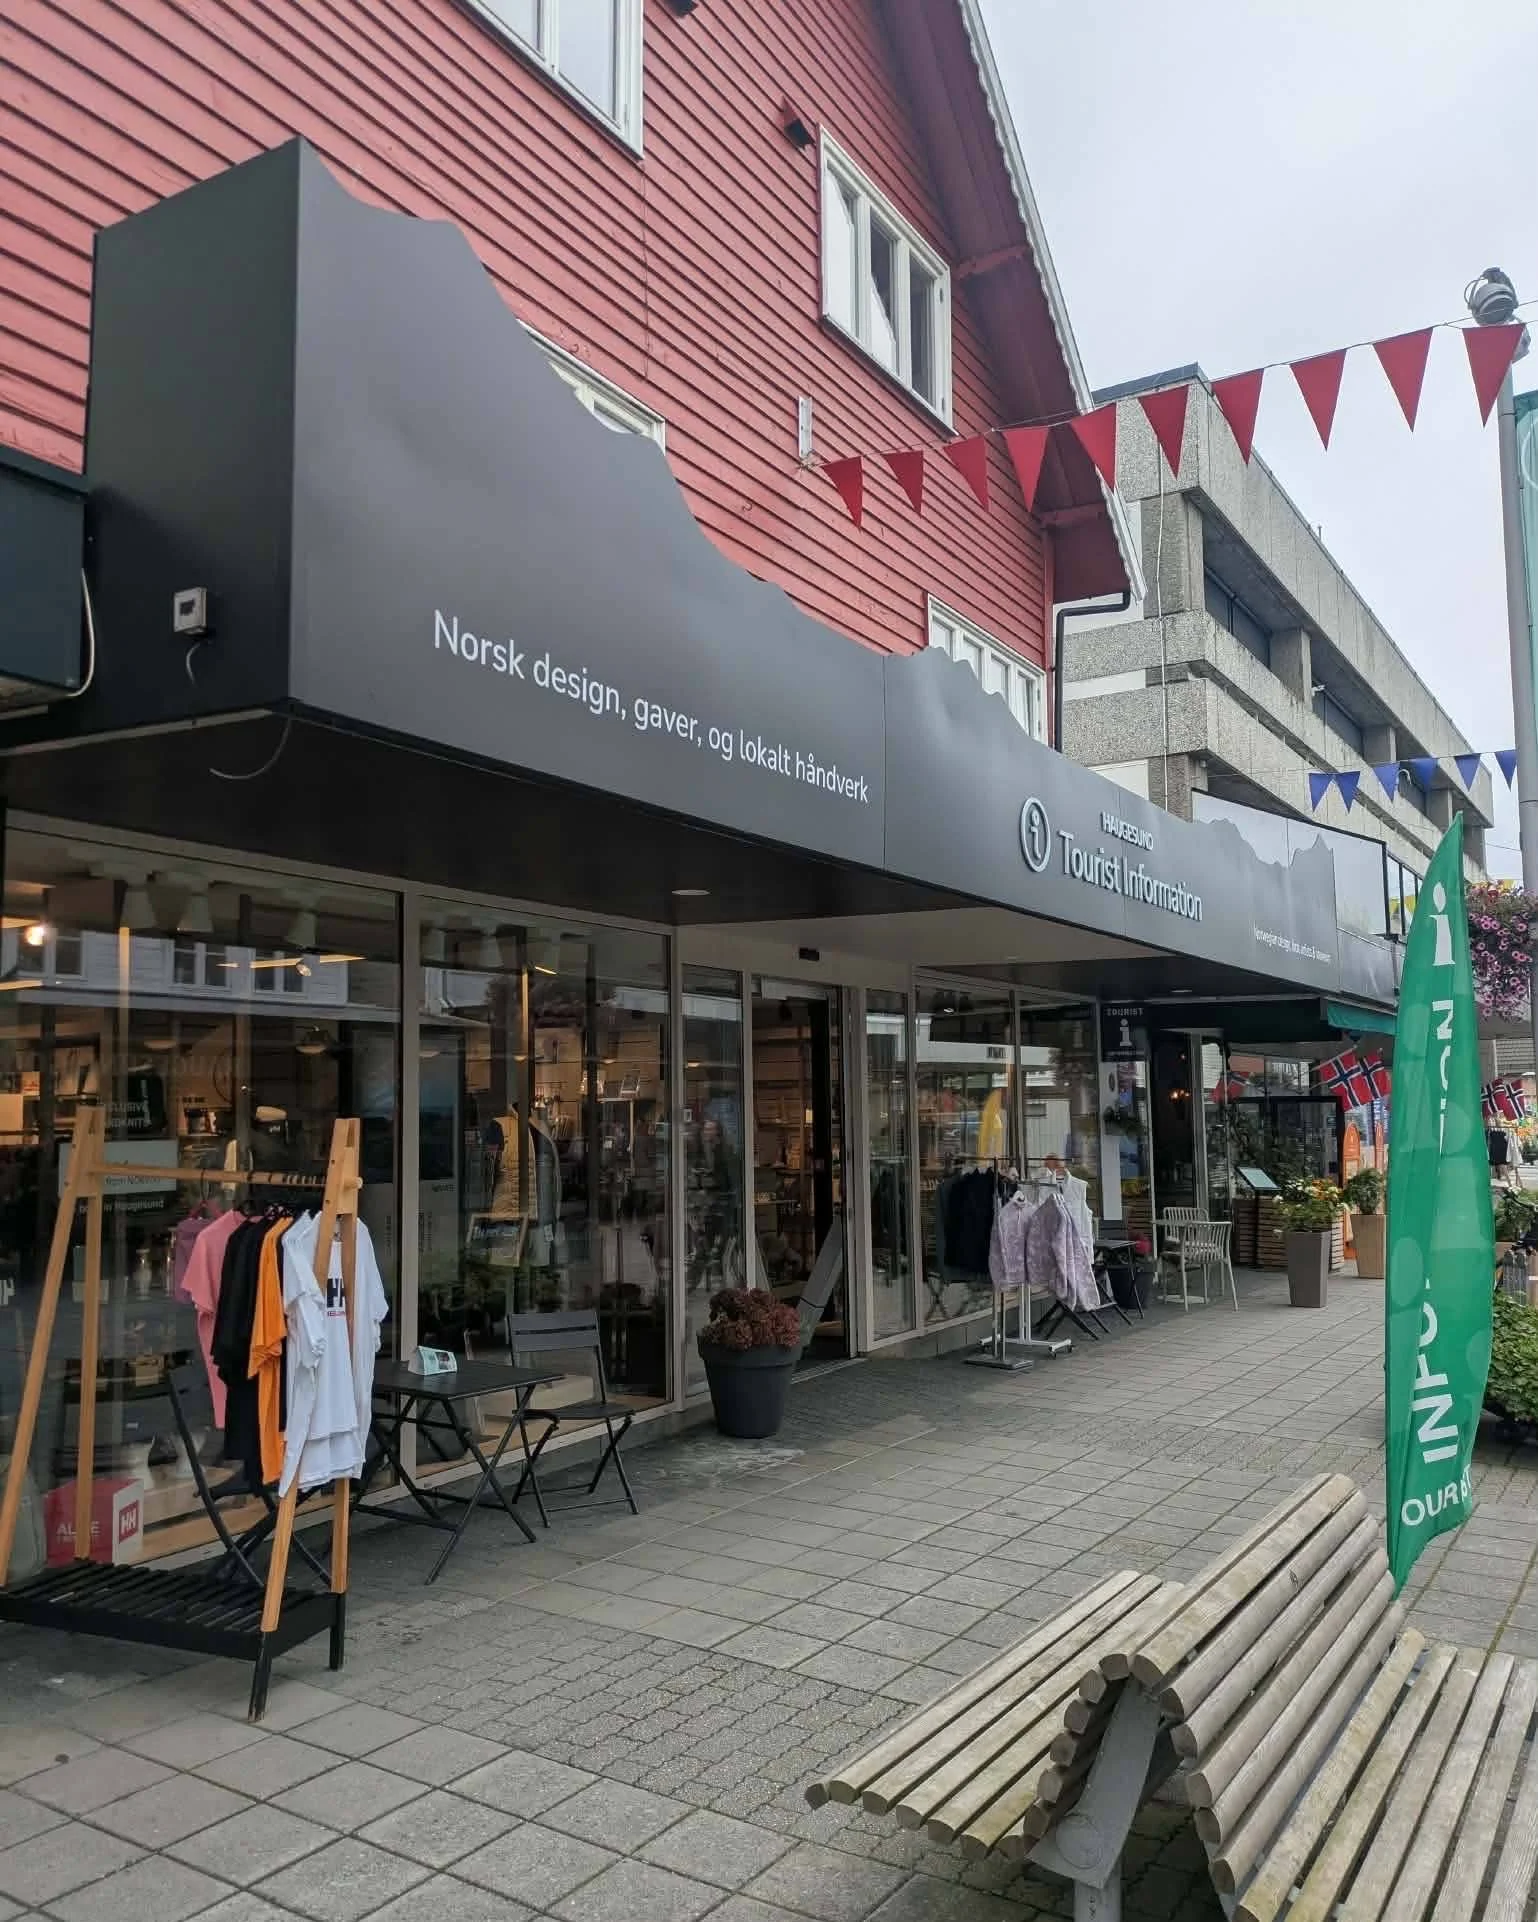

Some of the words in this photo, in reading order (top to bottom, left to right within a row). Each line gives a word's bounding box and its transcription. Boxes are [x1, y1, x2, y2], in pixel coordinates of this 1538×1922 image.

[434, 609, 525, 680] Norsk
[533, 652, 626, 721] design,
[634, 697, 702, 748] gaver,
[708, 727, 733, 761] og
[740, 730, 791, 777] lokalt
[795, 752, 868, 803] håndverk
[1058, 830, 1121, 893] Tourist
[1123, 856, 1202, 920] Information
[1101, 811, 1154, 851] HAUGESUND
